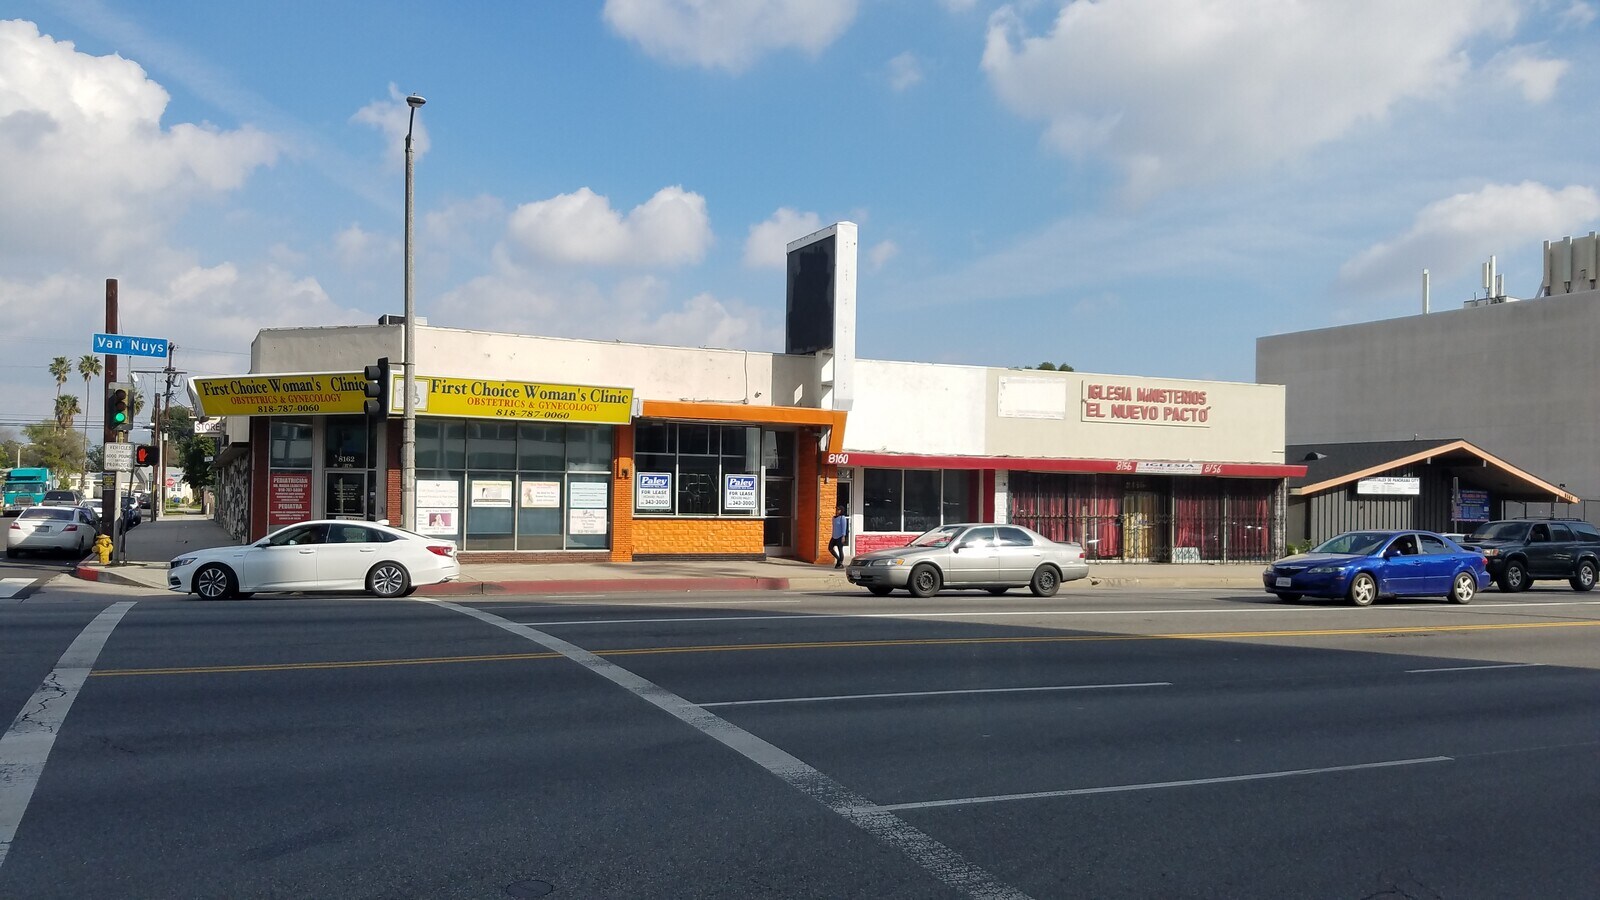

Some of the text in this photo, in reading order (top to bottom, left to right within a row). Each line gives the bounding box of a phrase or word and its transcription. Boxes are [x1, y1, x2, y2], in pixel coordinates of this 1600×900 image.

[97, 336, 164, 354] Van Nuys
[201, 376, 365, 396] First Choice Woman's Clinic
[430, 379, 629, 404] First Choice Woman's Clinic
[1087, 384, 1133, 402] IGLESIA
[230, 393, 342, 405] OBSTETRICS & GYNECOLOGY
[257, 404, 320, 413] 818-787-0060
[467, 397, 599, 412] OBSTETRICS & GYNECOLOGY
[495, 409, 570, 419] 818-787-0060
[1086, 402, 1208, 423] EL NUEVO PACTO
[195, 423, 220, 431] STORE
[338, 455, 355, 463] 8162
[828, 453, 849, 464] 8160
[1116, 461, 1133, 471] 8156
[1204, 464, 1222, 474] 8156
[641, 476, 668, 486] Paley
[729, 478, 754, 487] Paley
